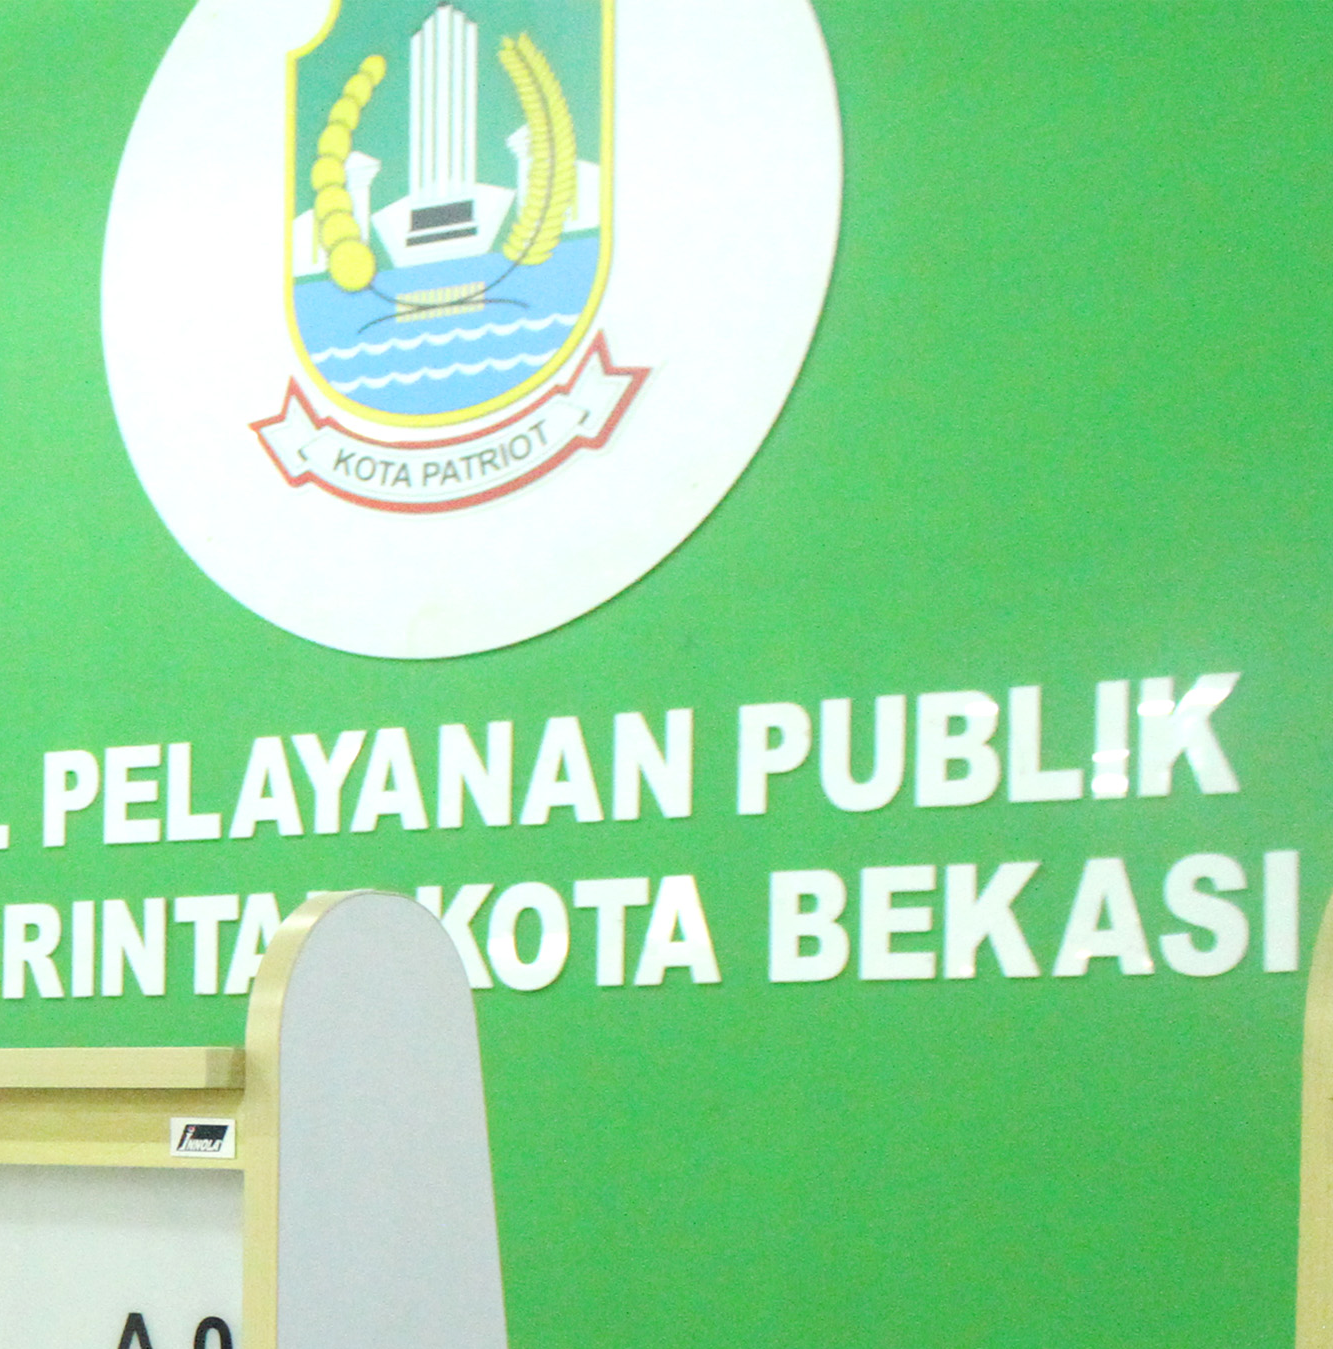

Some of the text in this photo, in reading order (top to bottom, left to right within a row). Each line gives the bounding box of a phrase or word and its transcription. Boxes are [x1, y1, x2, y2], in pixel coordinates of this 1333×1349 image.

[333, 420, 551, 488] KOTA PATRIOT
[43, 710, 693, 848] PELAYANAN
[737, 672, 1242, 815] PUBLIK
[415, 874, 722, 992] KOTA
[768, 849, 1300, 983] BEKASI
